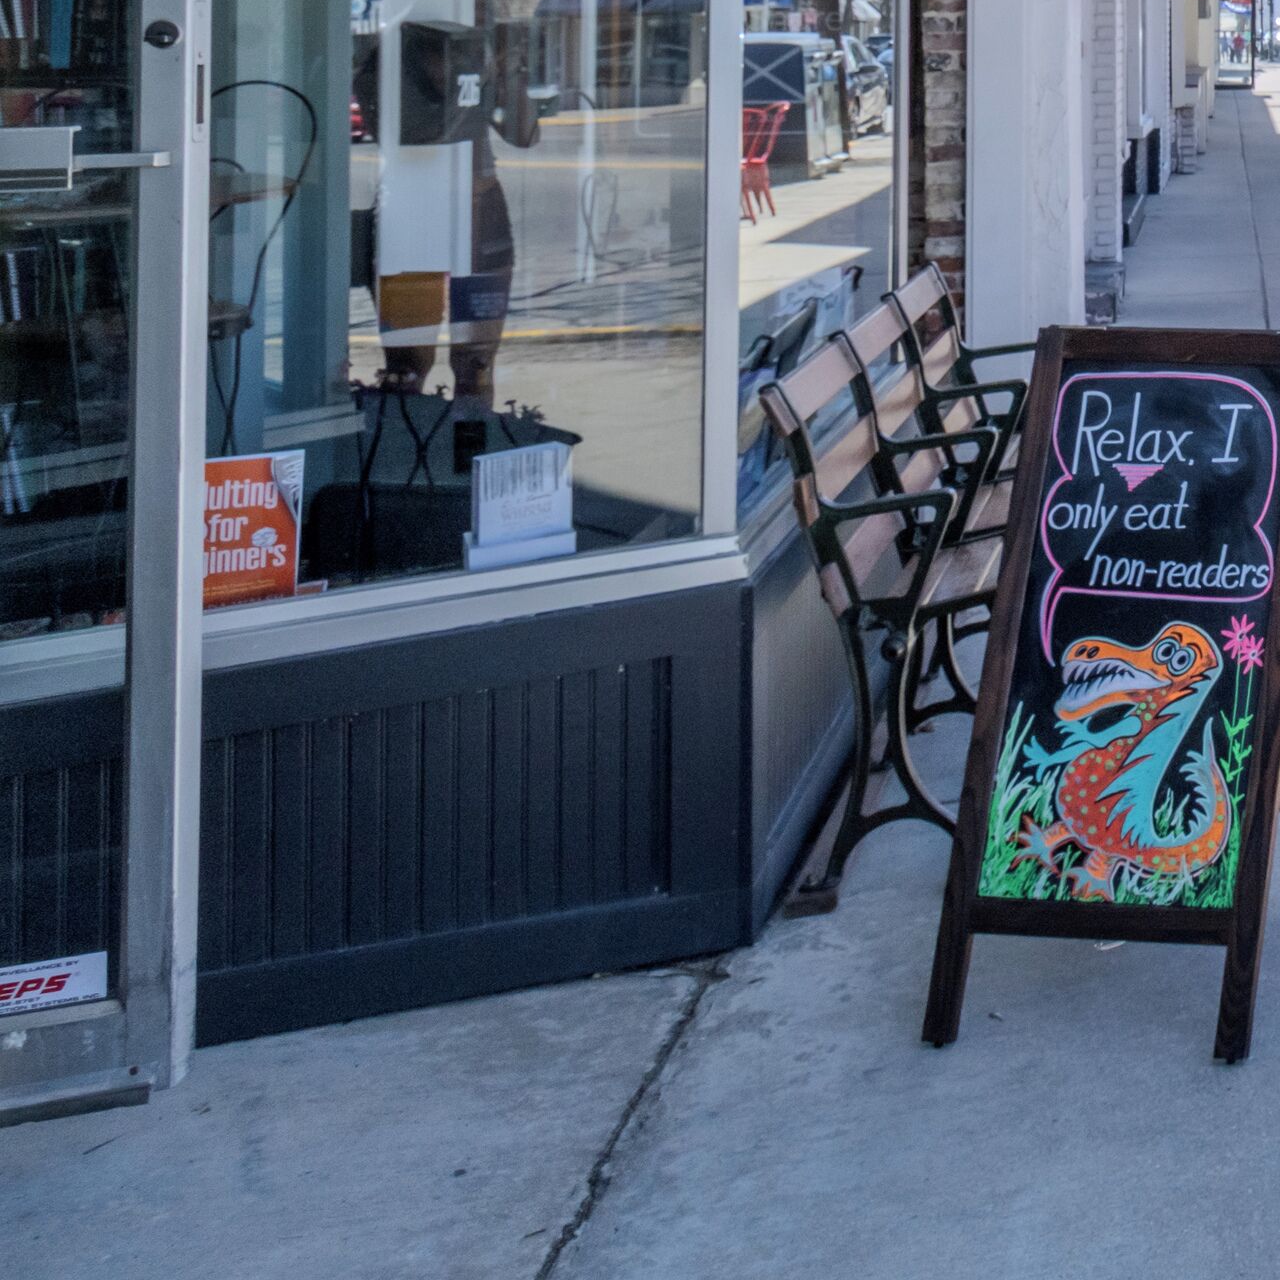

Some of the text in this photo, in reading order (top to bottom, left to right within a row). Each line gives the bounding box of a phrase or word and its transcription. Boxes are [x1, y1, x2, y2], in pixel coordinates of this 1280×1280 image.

[1211, 403, 1254, 463] I
[209, 514, 249, 543] for
[1047, 480, 1190, 561] only eat
[1088, 543, 1270, 589] non-readers
